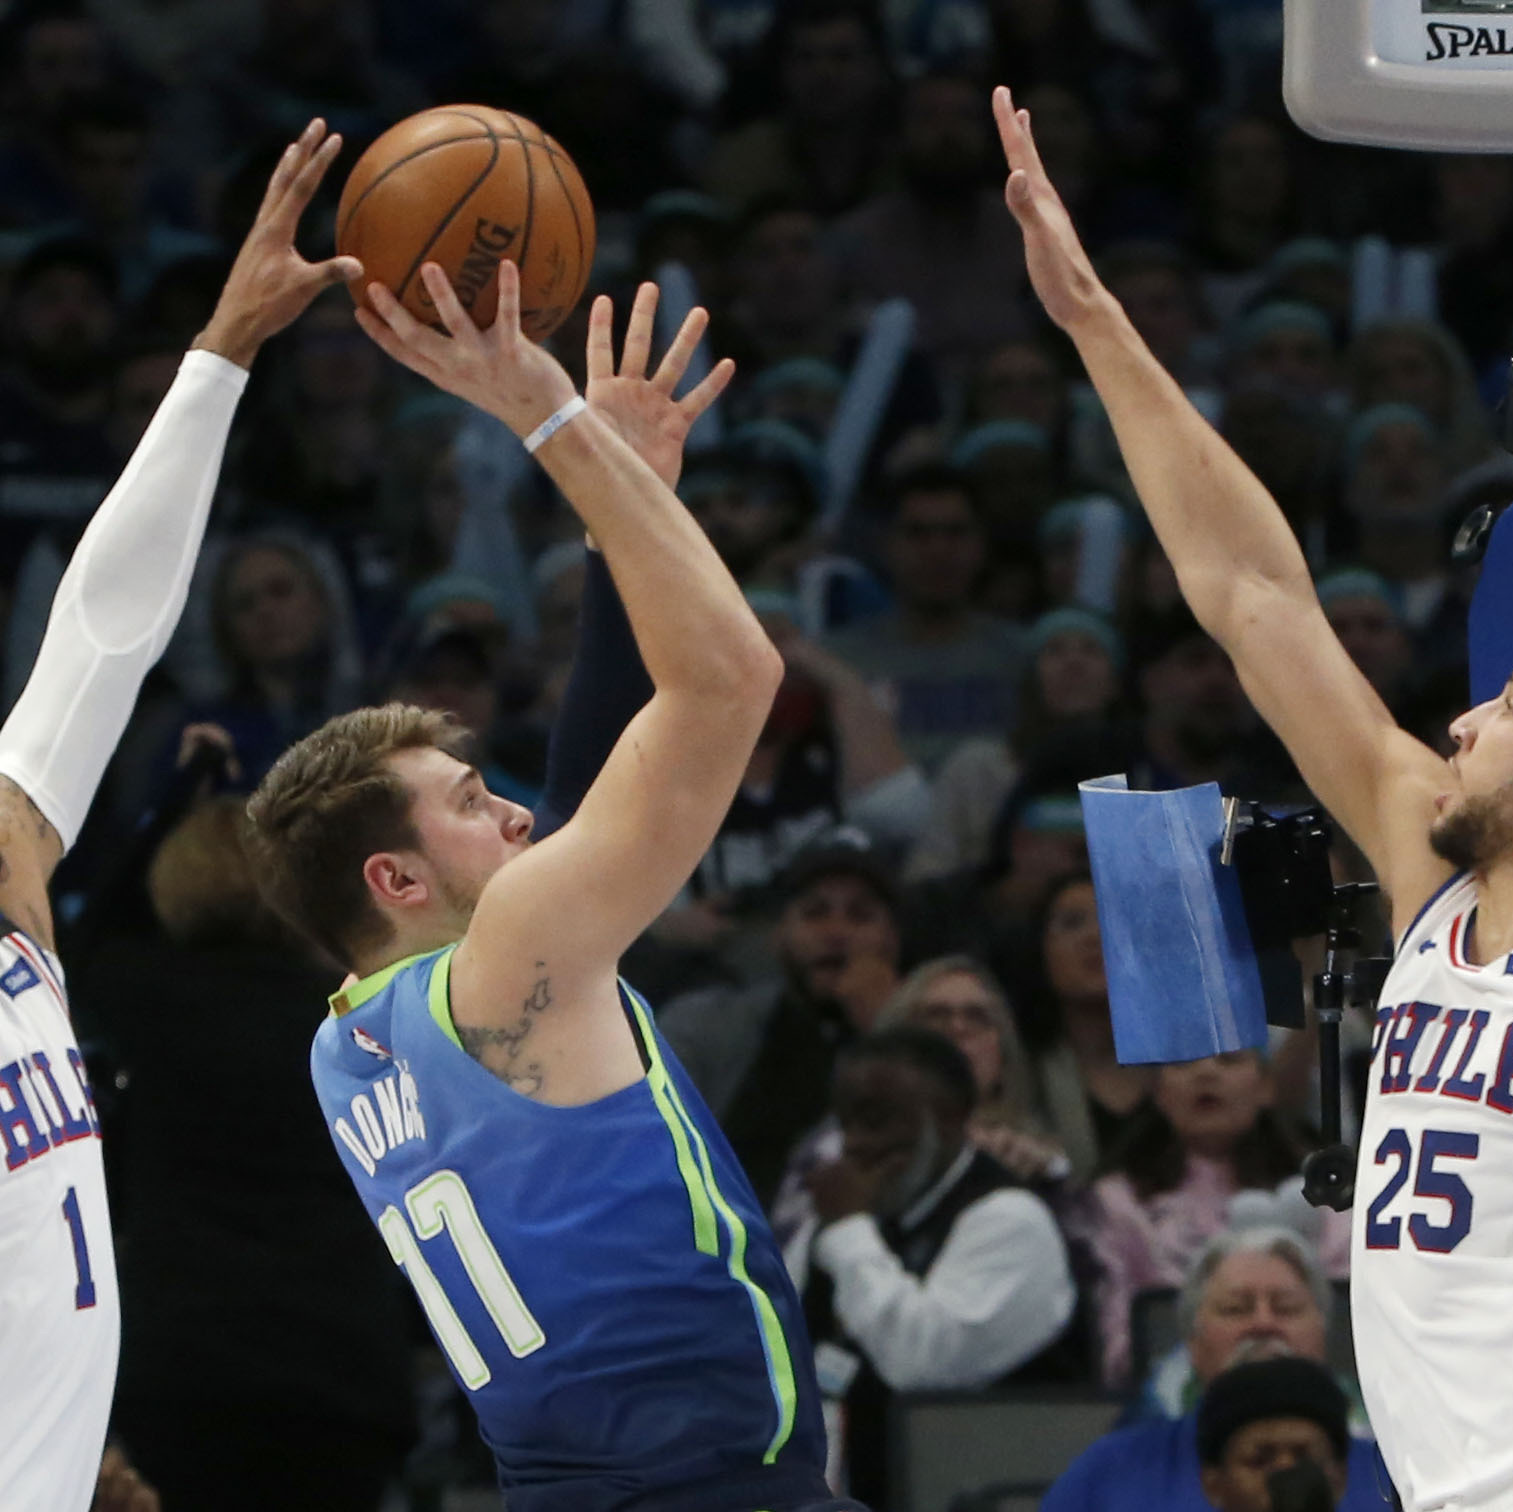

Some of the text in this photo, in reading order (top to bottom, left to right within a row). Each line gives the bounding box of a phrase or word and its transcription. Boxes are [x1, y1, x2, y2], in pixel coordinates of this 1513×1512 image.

[62, 1186, 96, 1310] 1
[1366, 1128, 1480, 1254] 25
[378, 1169, 546, 1392] 77
